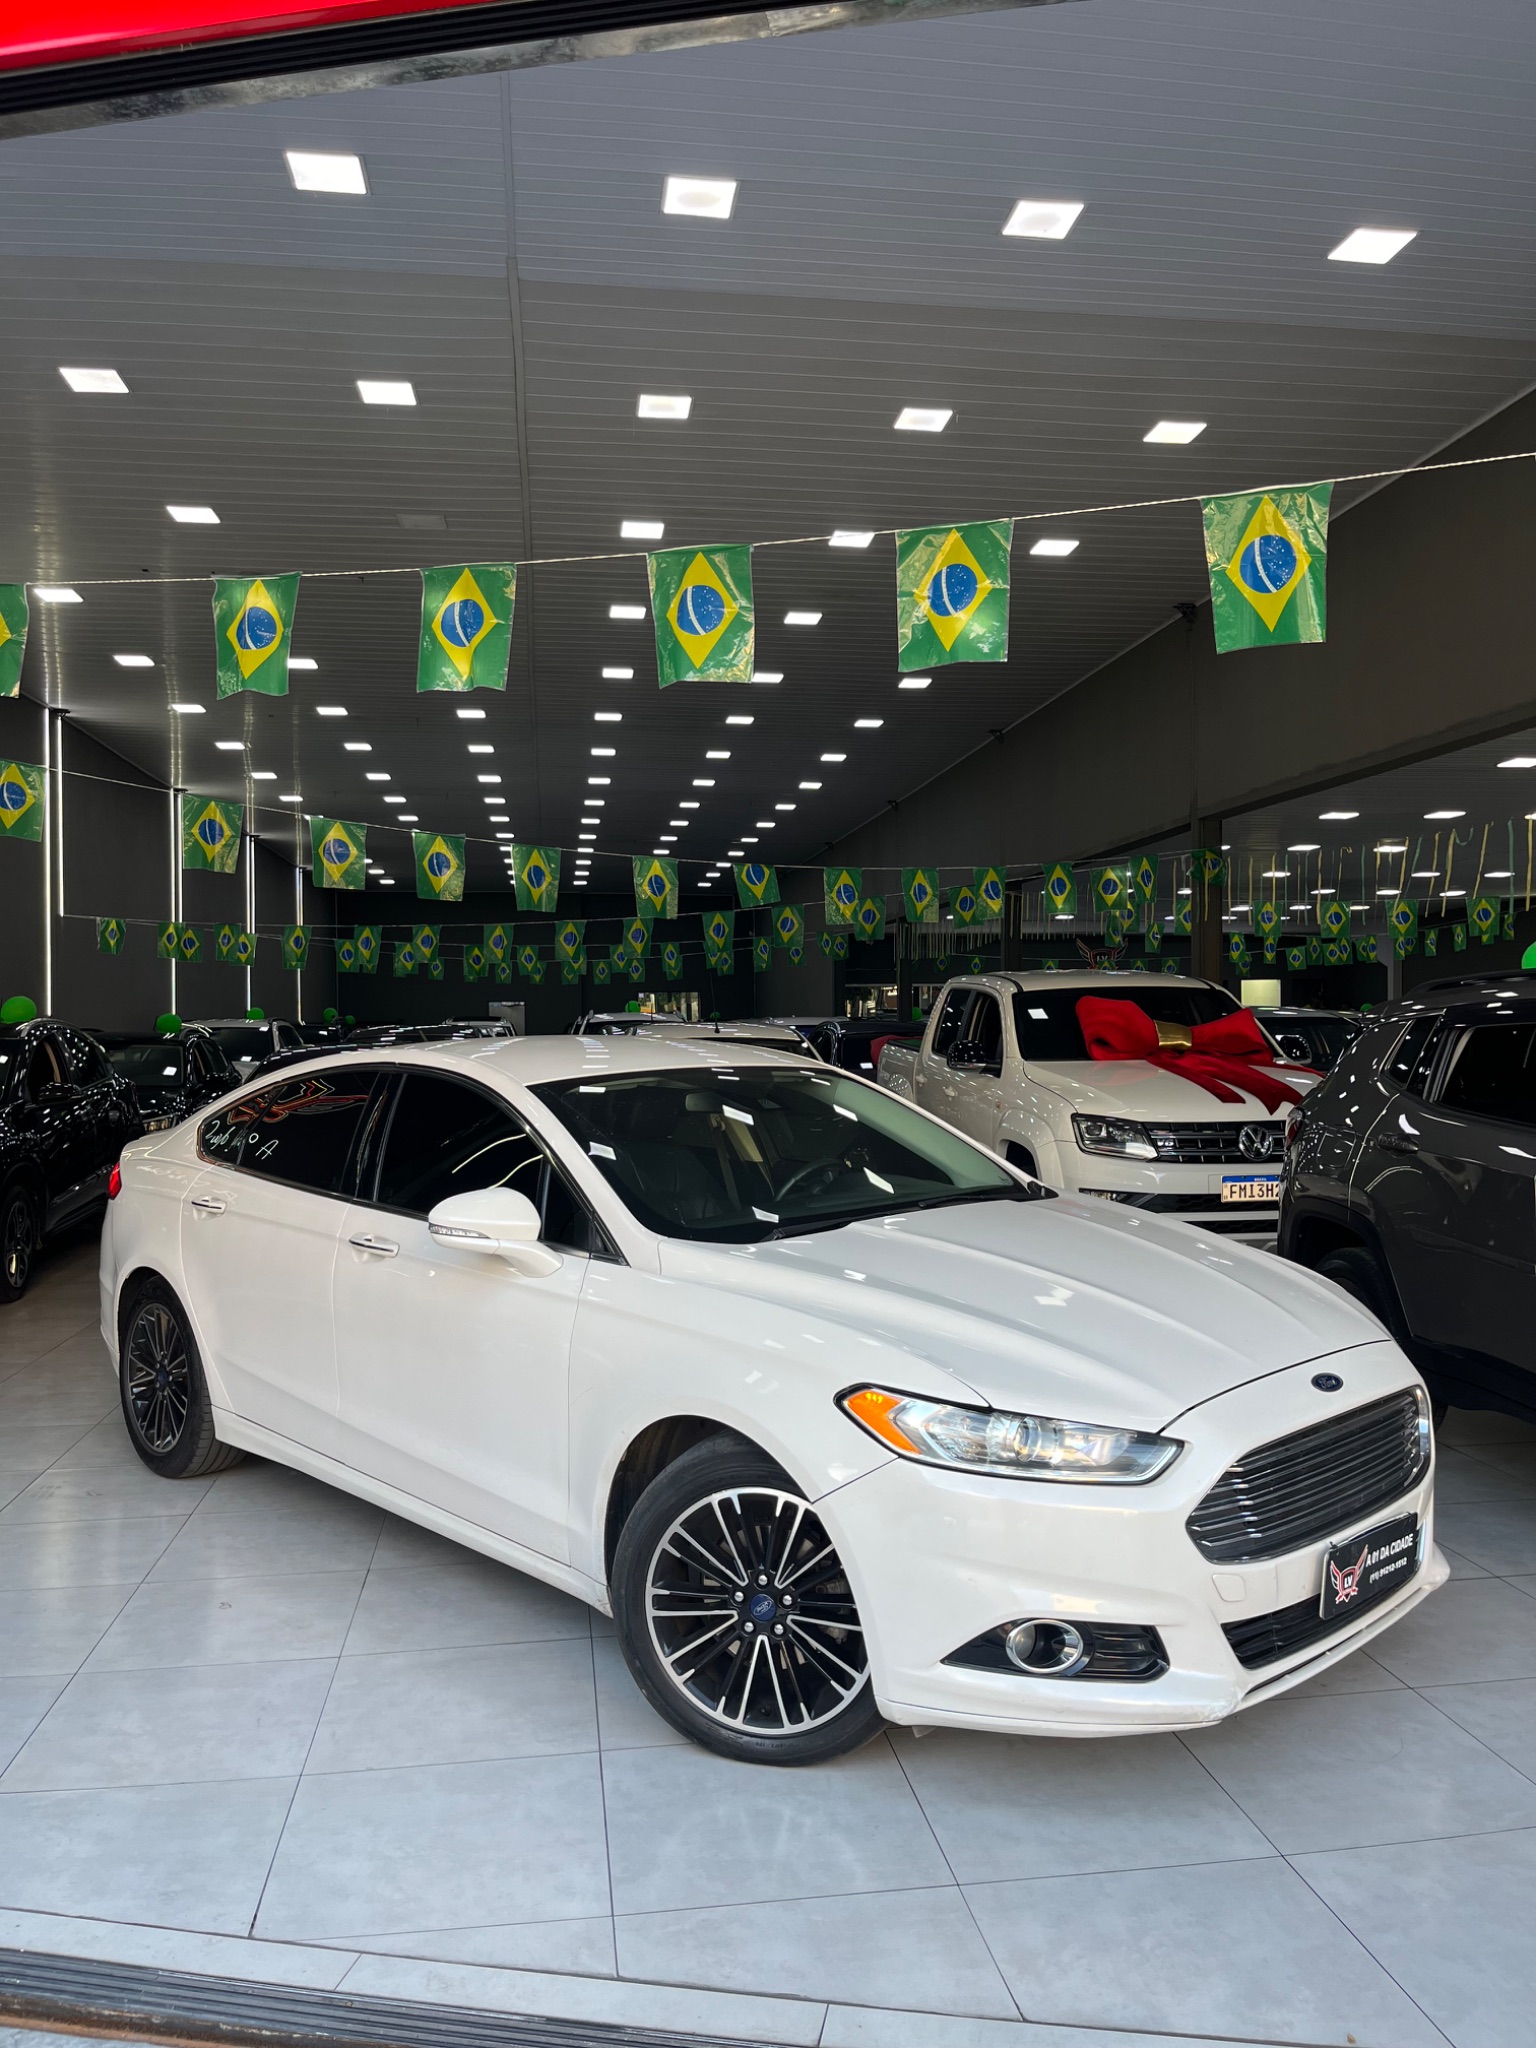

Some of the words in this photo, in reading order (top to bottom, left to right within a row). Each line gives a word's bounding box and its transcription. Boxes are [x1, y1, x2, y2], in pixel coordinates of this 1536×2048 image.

[1365, 1553, 1372, 1568] A
[1379, 1544, 1390, 1560] DA
[1390, 1533, 1414, 1555] CIDADE
[1344, 1574, 1353, 1588] LV
